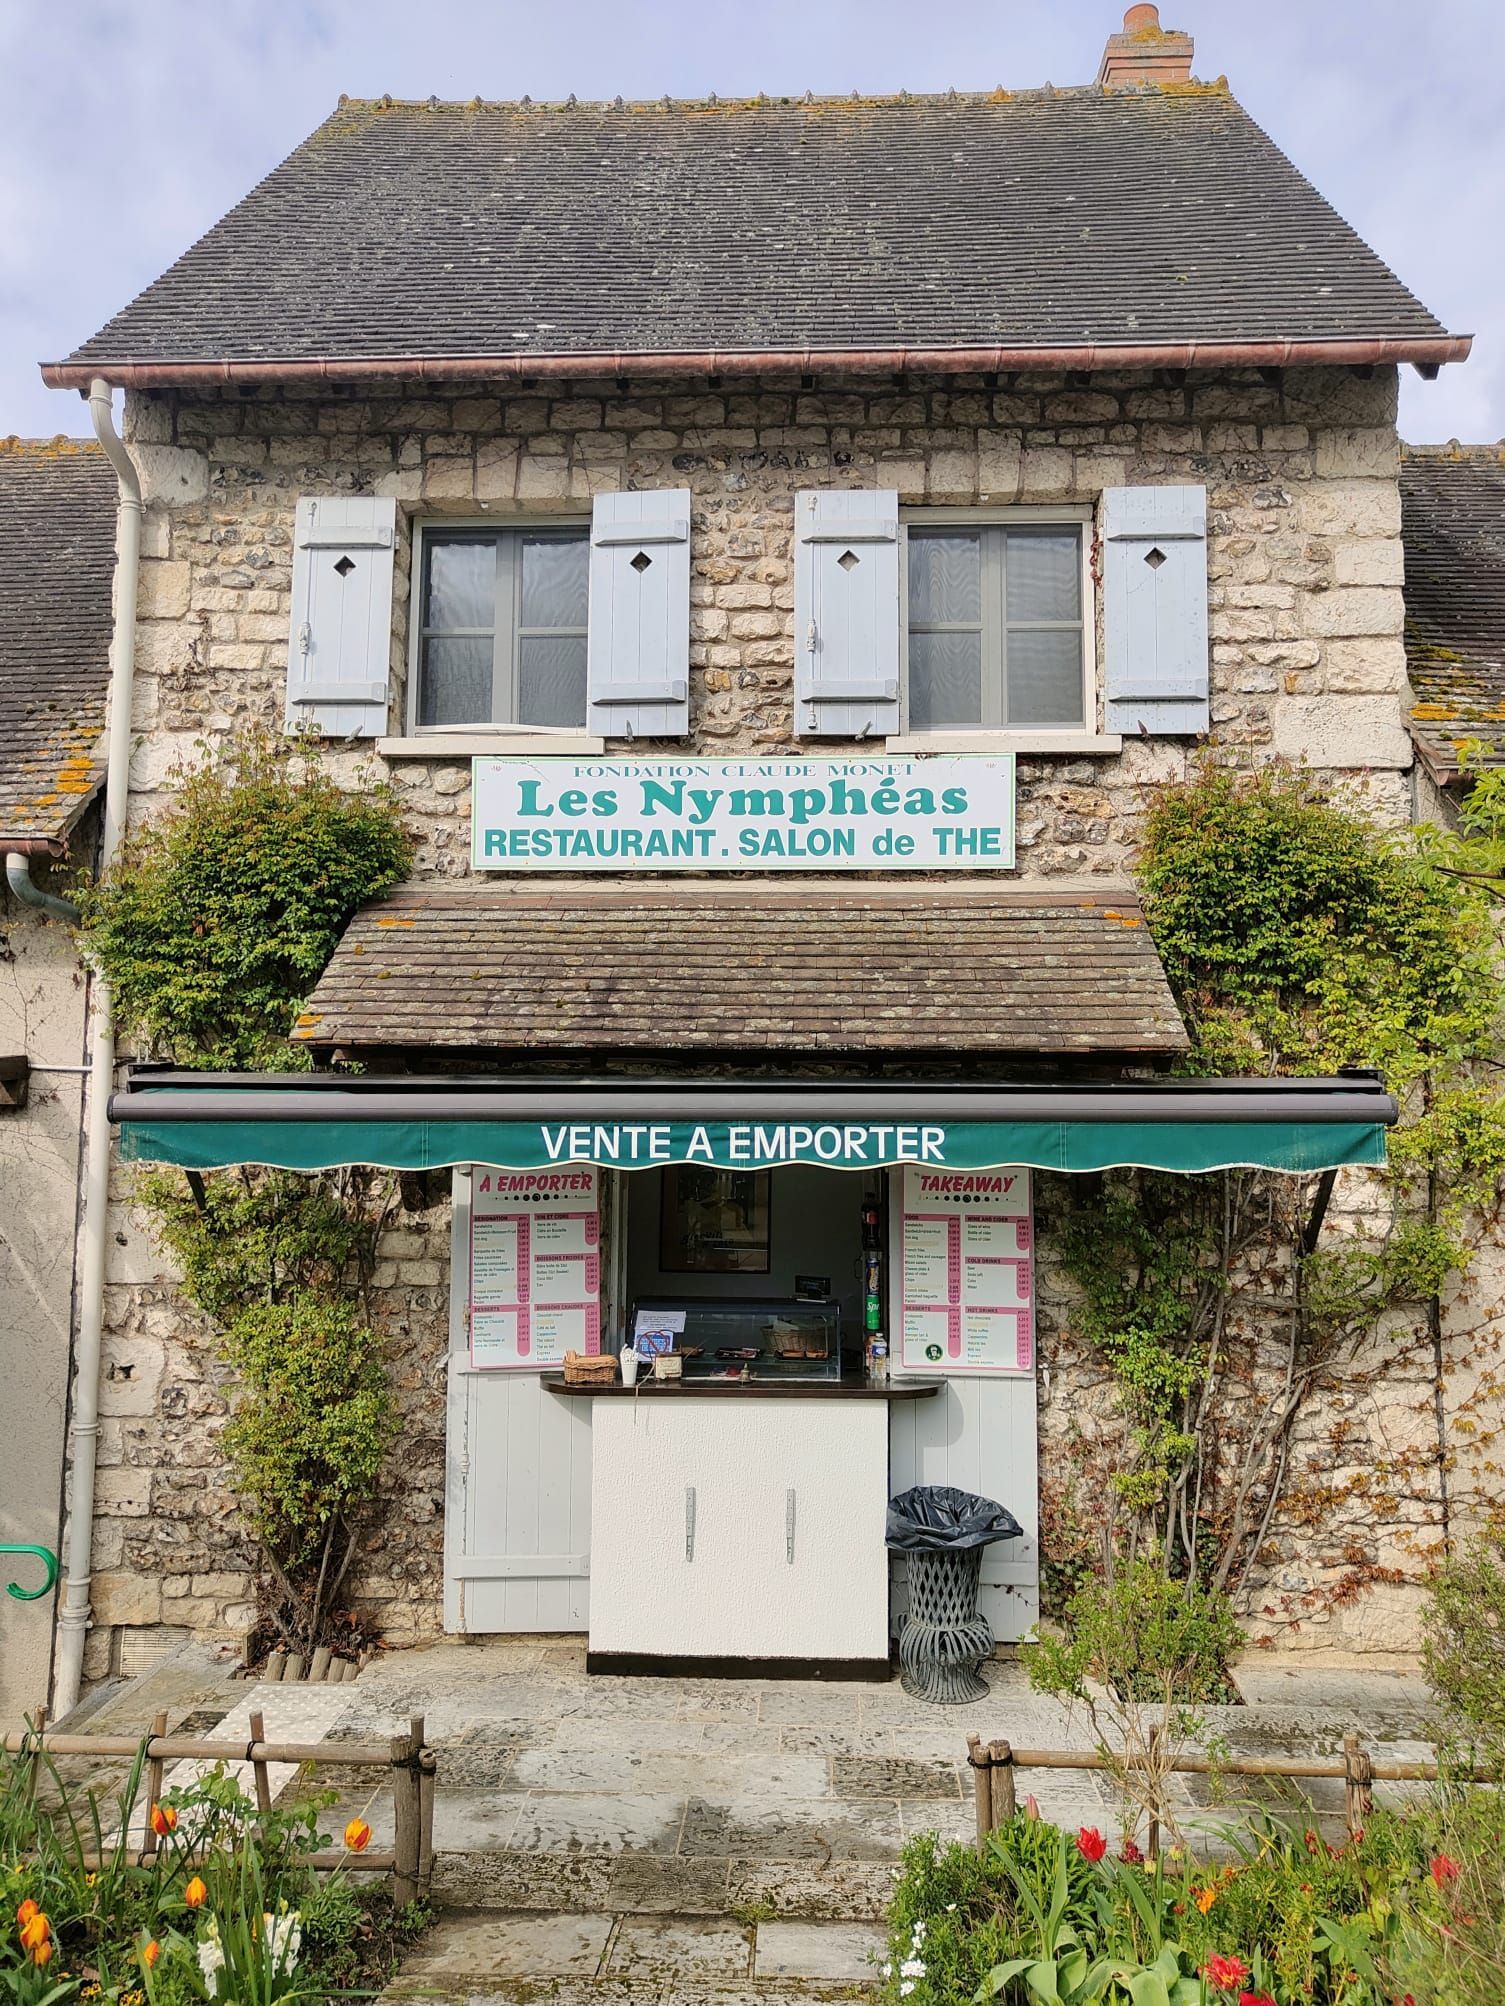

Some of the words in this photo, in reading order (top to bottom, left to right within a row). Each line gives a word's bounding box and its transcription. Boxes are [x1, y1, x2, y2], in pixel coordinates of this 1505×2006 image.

[573, 764, 711, 778] FONDATION
[721, 764, 816, 777] CLAUDE
[827, 763, 916, 776] MONET
[517, 779, 619, 817] Les
[639, 777, 968, 824] Nymphéas
[738, 827, 855, 858] SALON
[872, 827, 915, 857] de
[932, 827, 1001, 856] THE
[541, 1126, 671, 1159] VENTE
[685, 1126, 714, 1159] A
[728, 1126, 945, 1160] EMPORTER
[497, 1173, 592, 1192] EMPORTER
[920, 1175, 1014, 1192] TAKEAWAY
